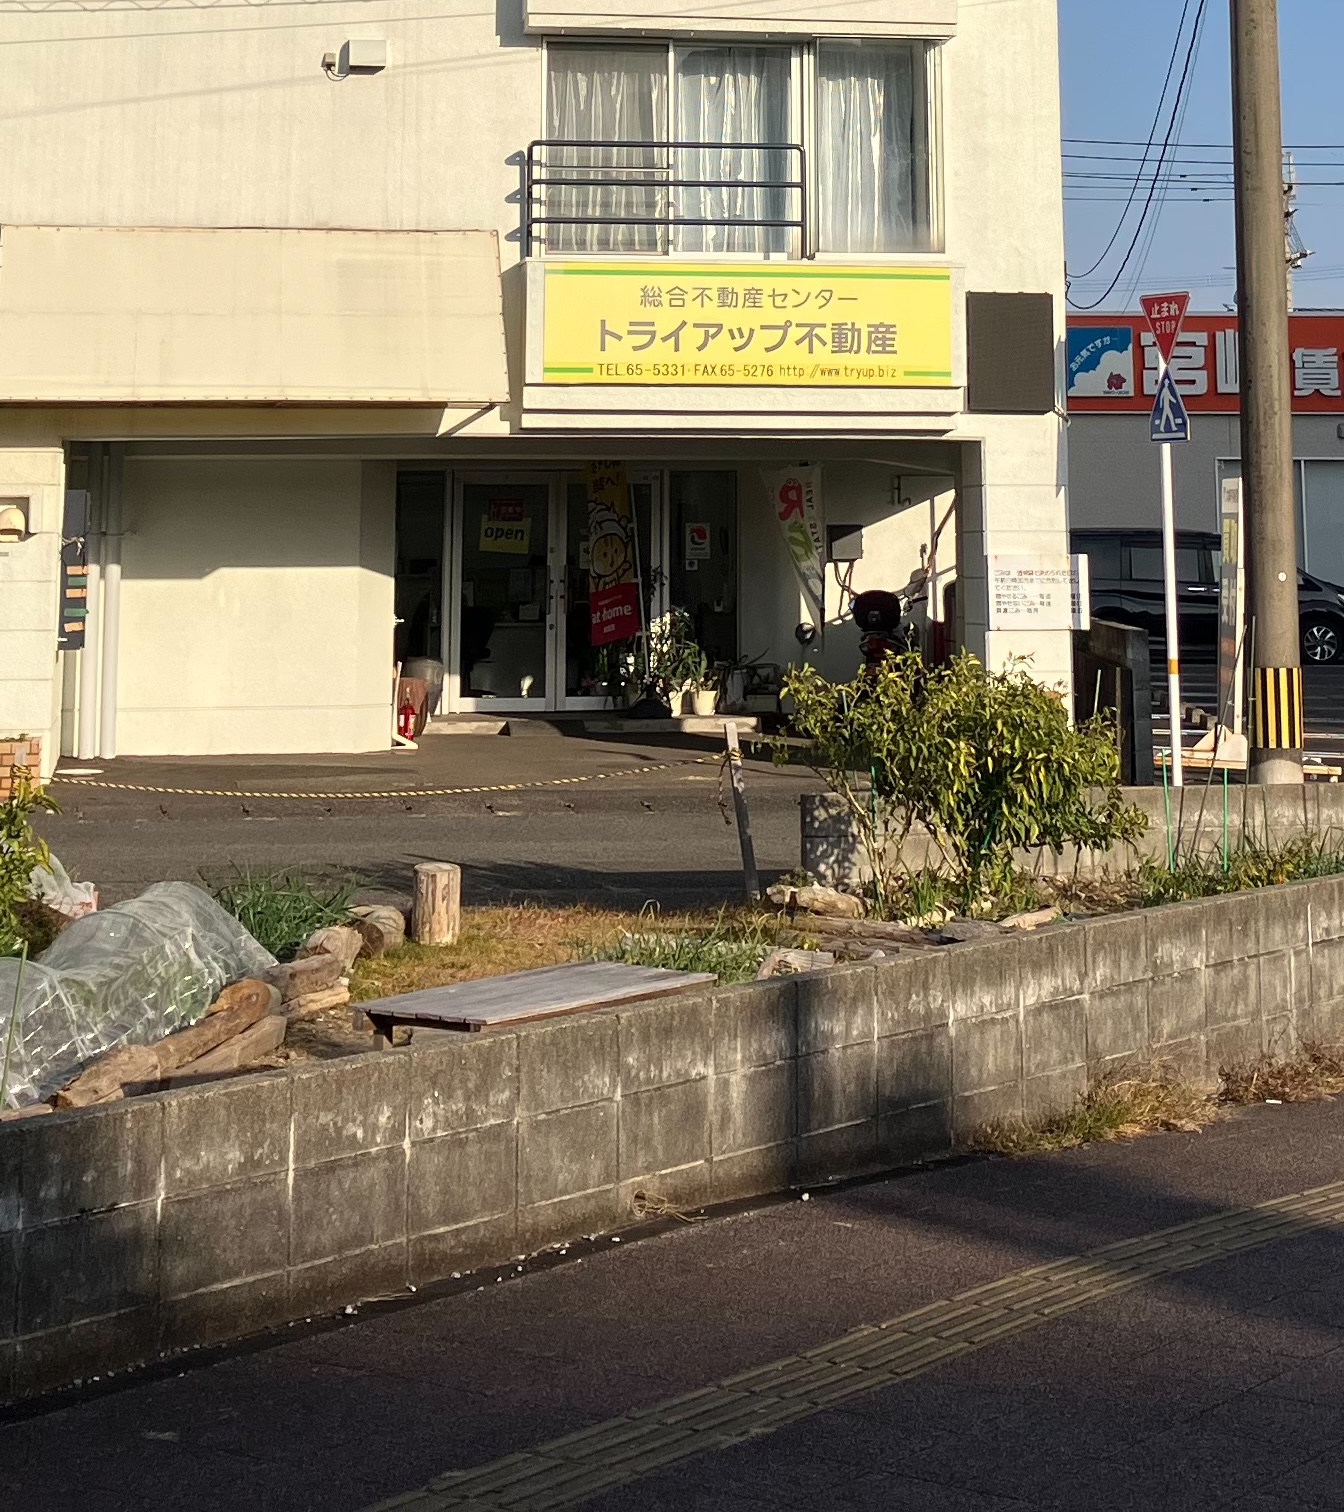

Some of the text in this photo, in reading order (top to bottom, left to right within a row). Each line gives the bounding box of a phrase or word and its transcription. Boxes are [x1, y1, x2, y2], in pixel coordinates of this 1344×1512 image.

[640, 284, 859, 309] 総合不動産センター
[1150, 300, 1180, 319] 止まれ
[599, 319, 898, 355] トライアップ不動産
[1155, 320, 1177, 335] STOP
[484, 526, 525, 541] open
